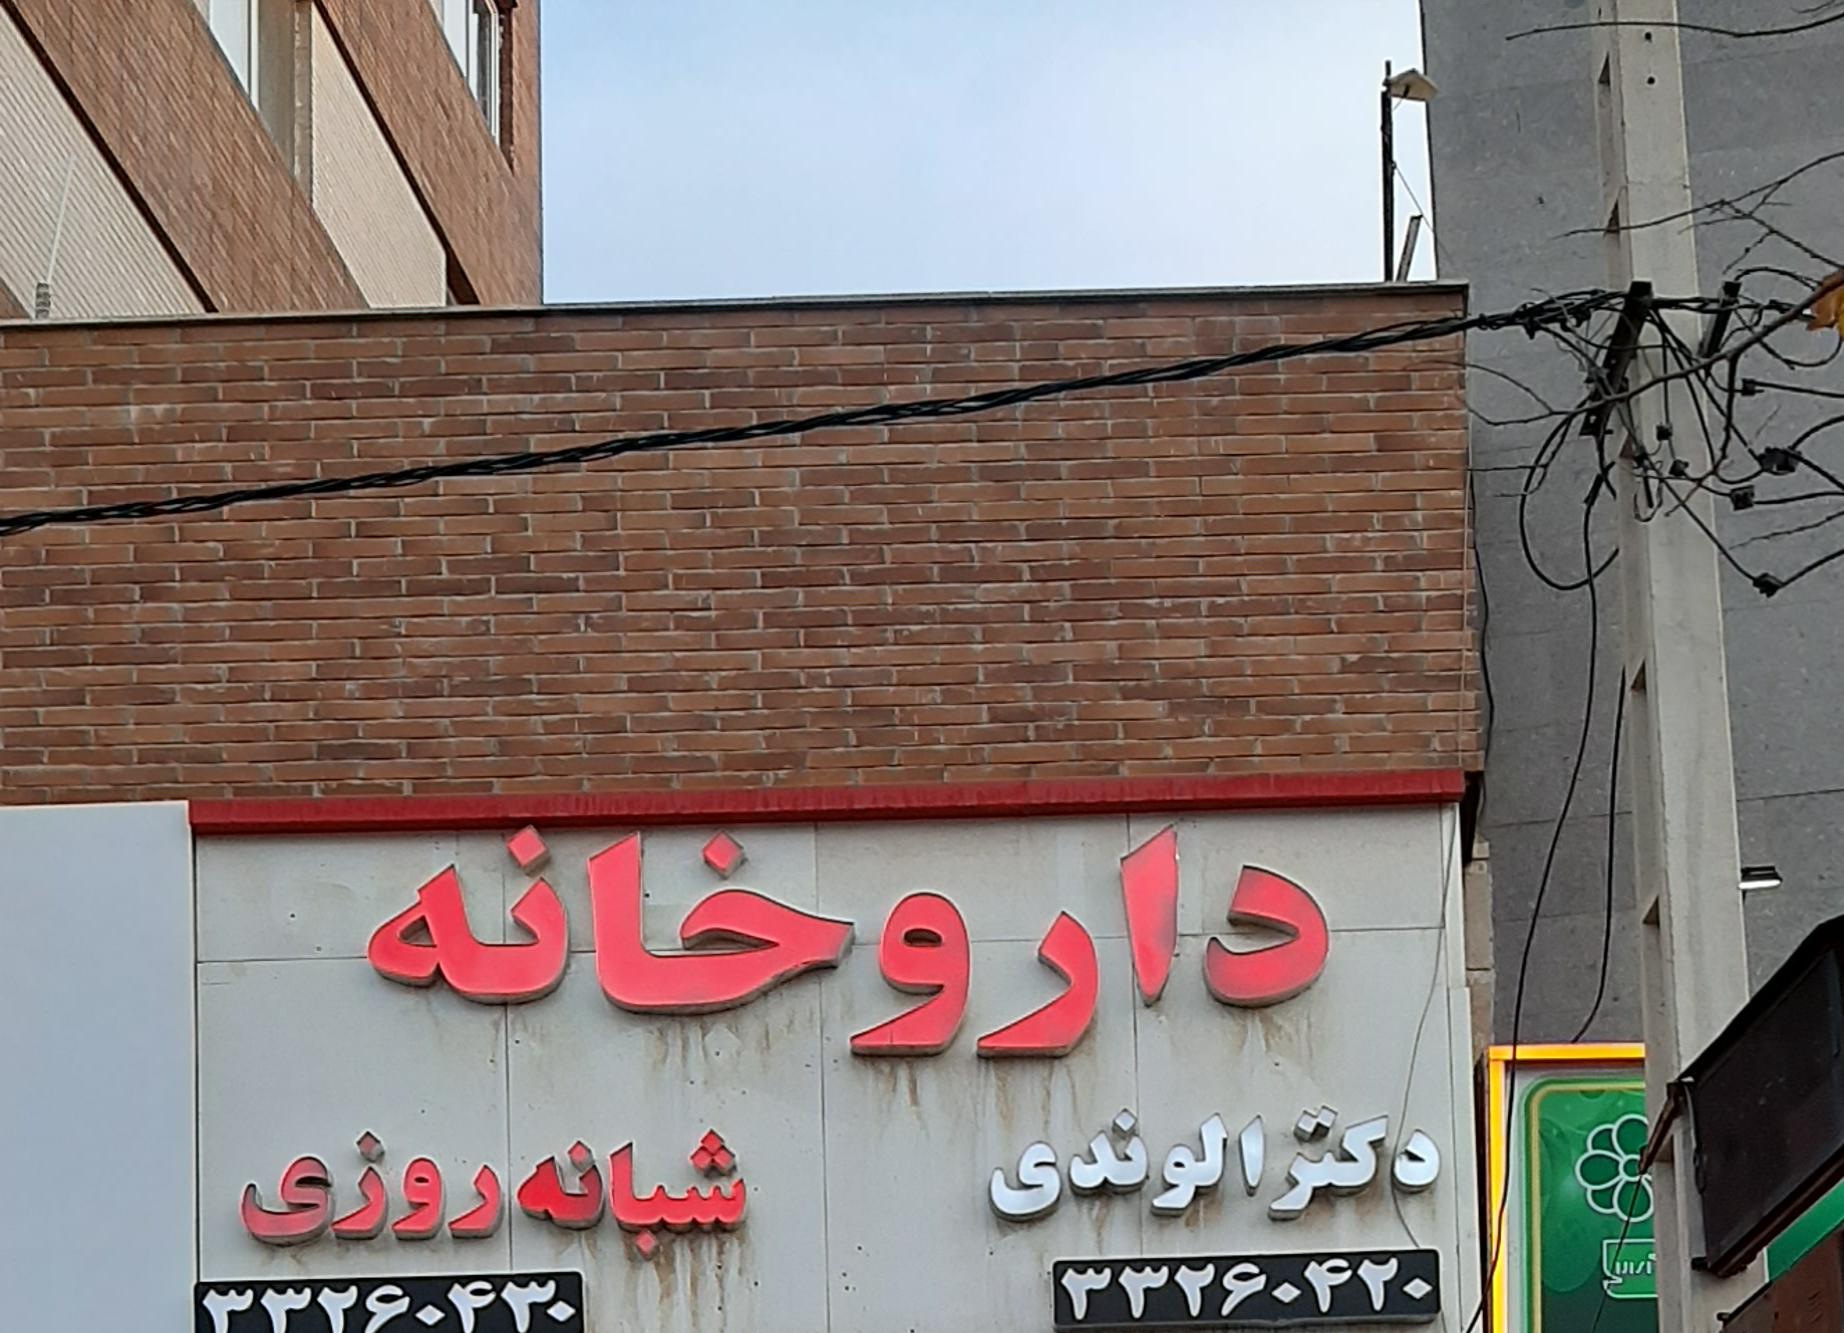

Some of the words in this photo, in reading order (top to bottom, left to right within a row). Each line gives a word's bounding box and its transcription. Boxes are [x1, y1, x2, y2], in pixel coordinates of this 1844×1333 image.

[367, 825, 1329, 1056] داروخانه
[240, 1131, 503, 1246] روزی
[516, 1130, 747, 1259] شبانه
[990, 1108, 1264, 1222] الوندی
[1269, 1106, 1440, 1220] دکتر
[1061, 1257, 1433, 1320] ۳۳۲۶۰۴۲۰
